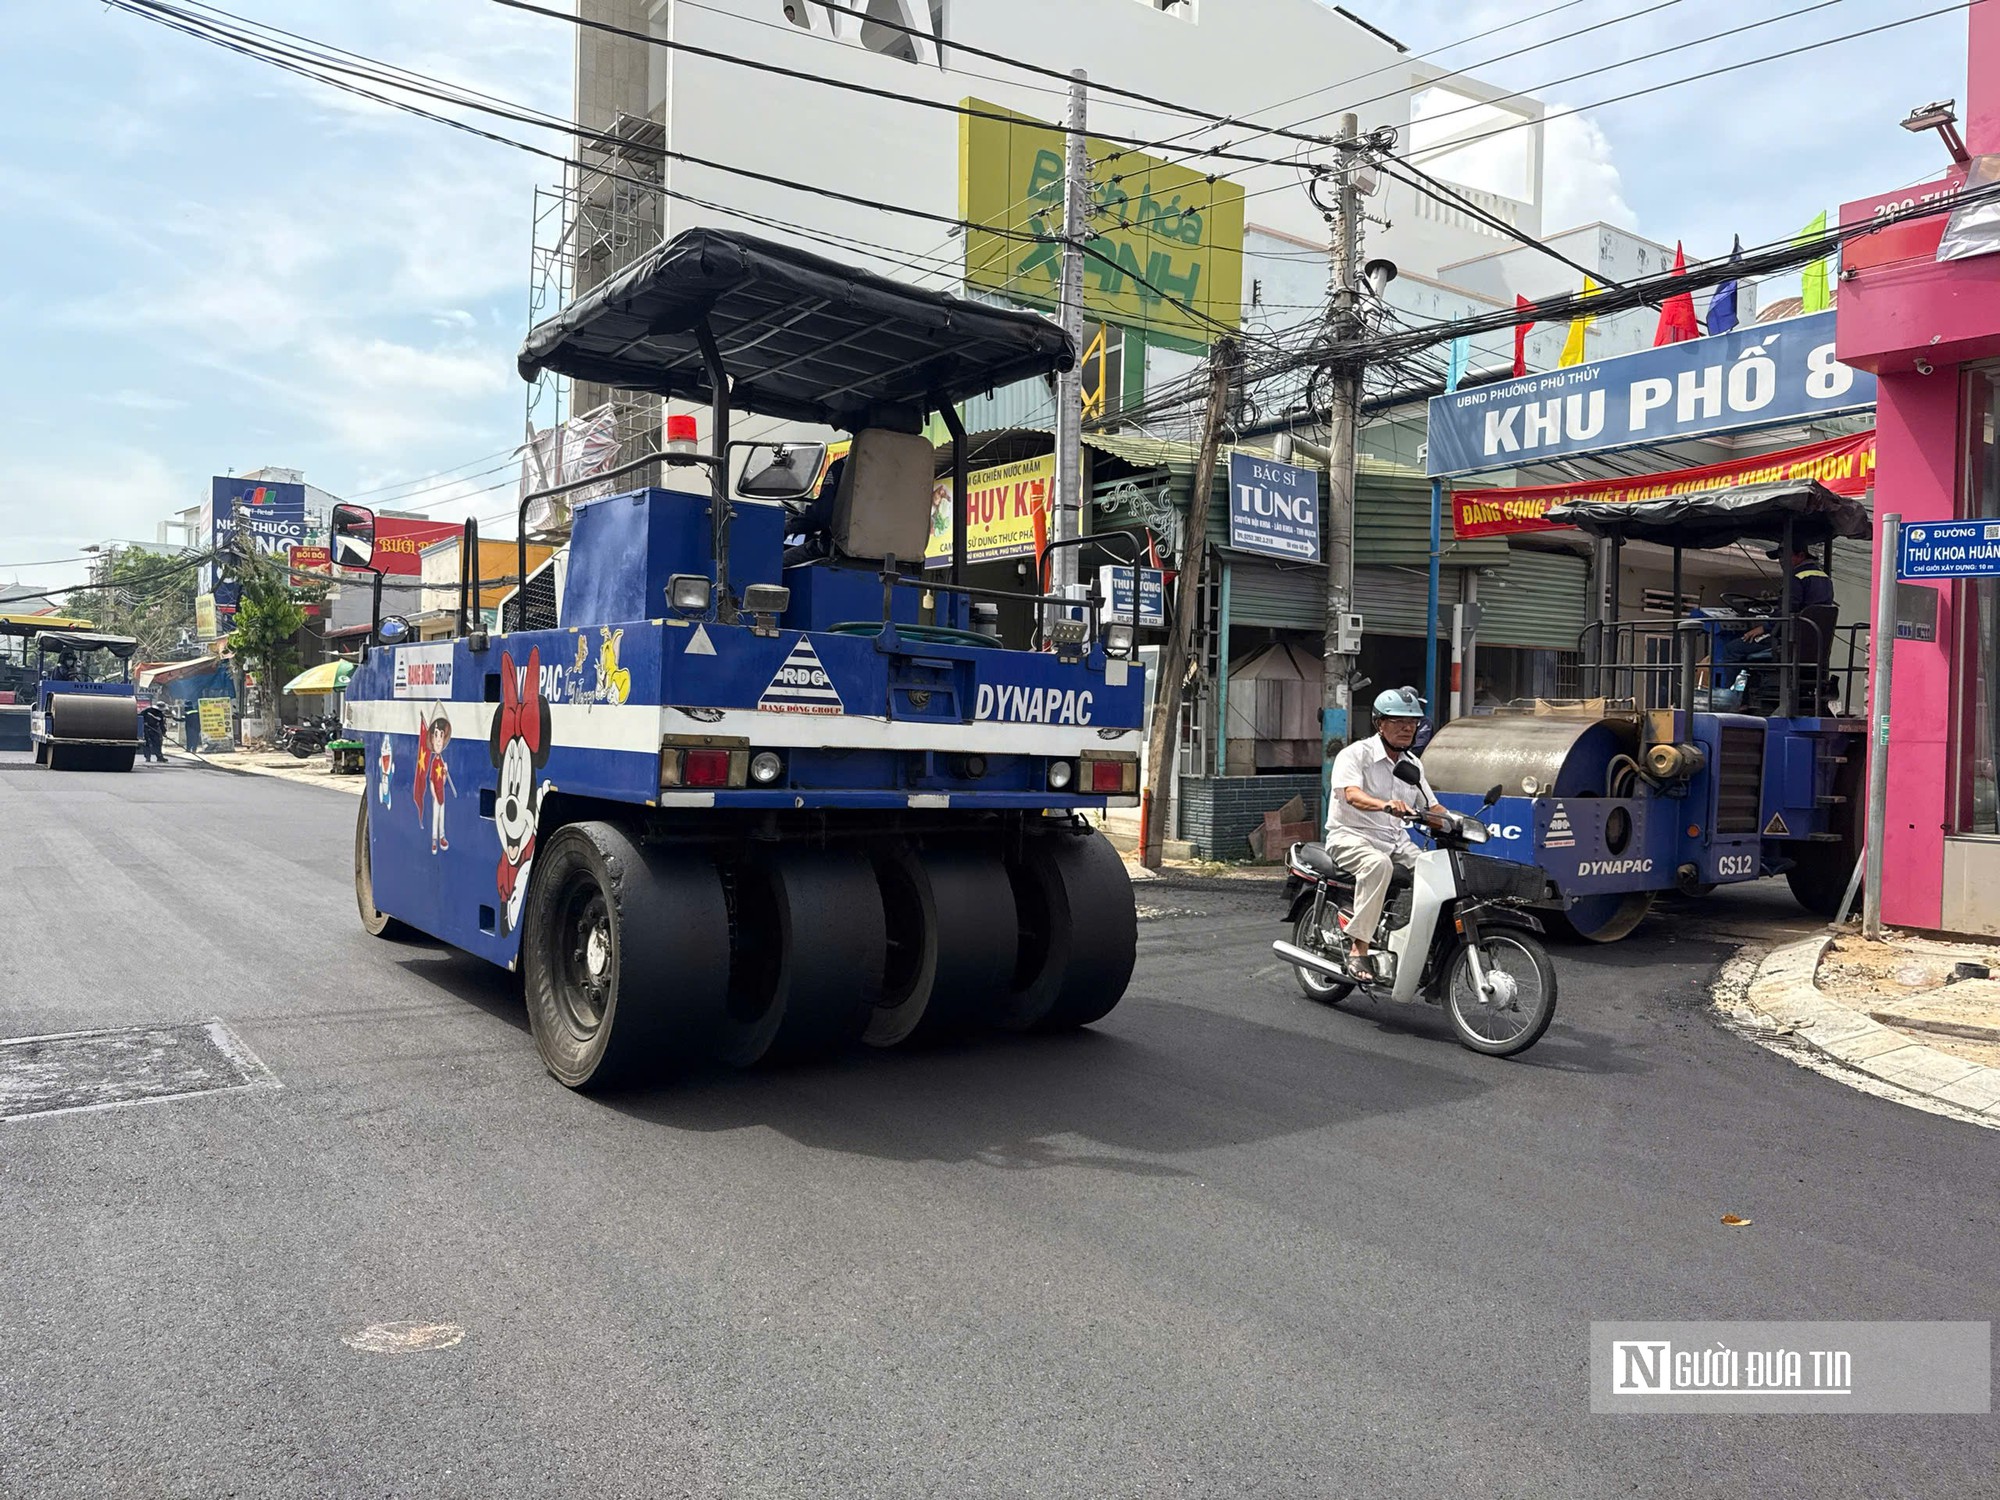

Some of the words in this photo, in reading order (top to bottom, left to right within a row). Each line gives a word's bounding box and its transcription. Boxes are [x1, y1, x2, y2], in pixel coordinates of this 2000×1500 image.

[1456, 391, 1487, 408] UBND
[1490, 381, 1537, 402] PHƯỜNG
[1539, 373, 1565, 394] PHÚ
[1568, 365, 1601, 386] THỦY
[1483, 389, 1606, 456] KHU
[1629, 333, 1781, 431] PHỐ
[1805, 342, 1854, 400] 8
[1253, 464, 1280, 483] BÁC
[1283, 471, 1296, 487] SĨ
[1236, 483, 1314, 525] TÙNG
[1463, 498, 1501, 526] ĐẢNG
[1503, 496, 1545, 524] CỘNG
[251, 520, 301, 536] THUỐC
[1934, 527, 1976, 539] ĐƯỜNG
[1908, 542, 1931, 561] THỦ
[1934, 546, 1966, 560] KHOA
[1969, 542, 2000, 559] HUÂN
[782, 668, 824, 687] RDG
[974, 683, 1093, 726] DYNAPAC
[1577, 858, 1653, 876] DYNAPAC
[1718, 855, 1752, 875] CS12
